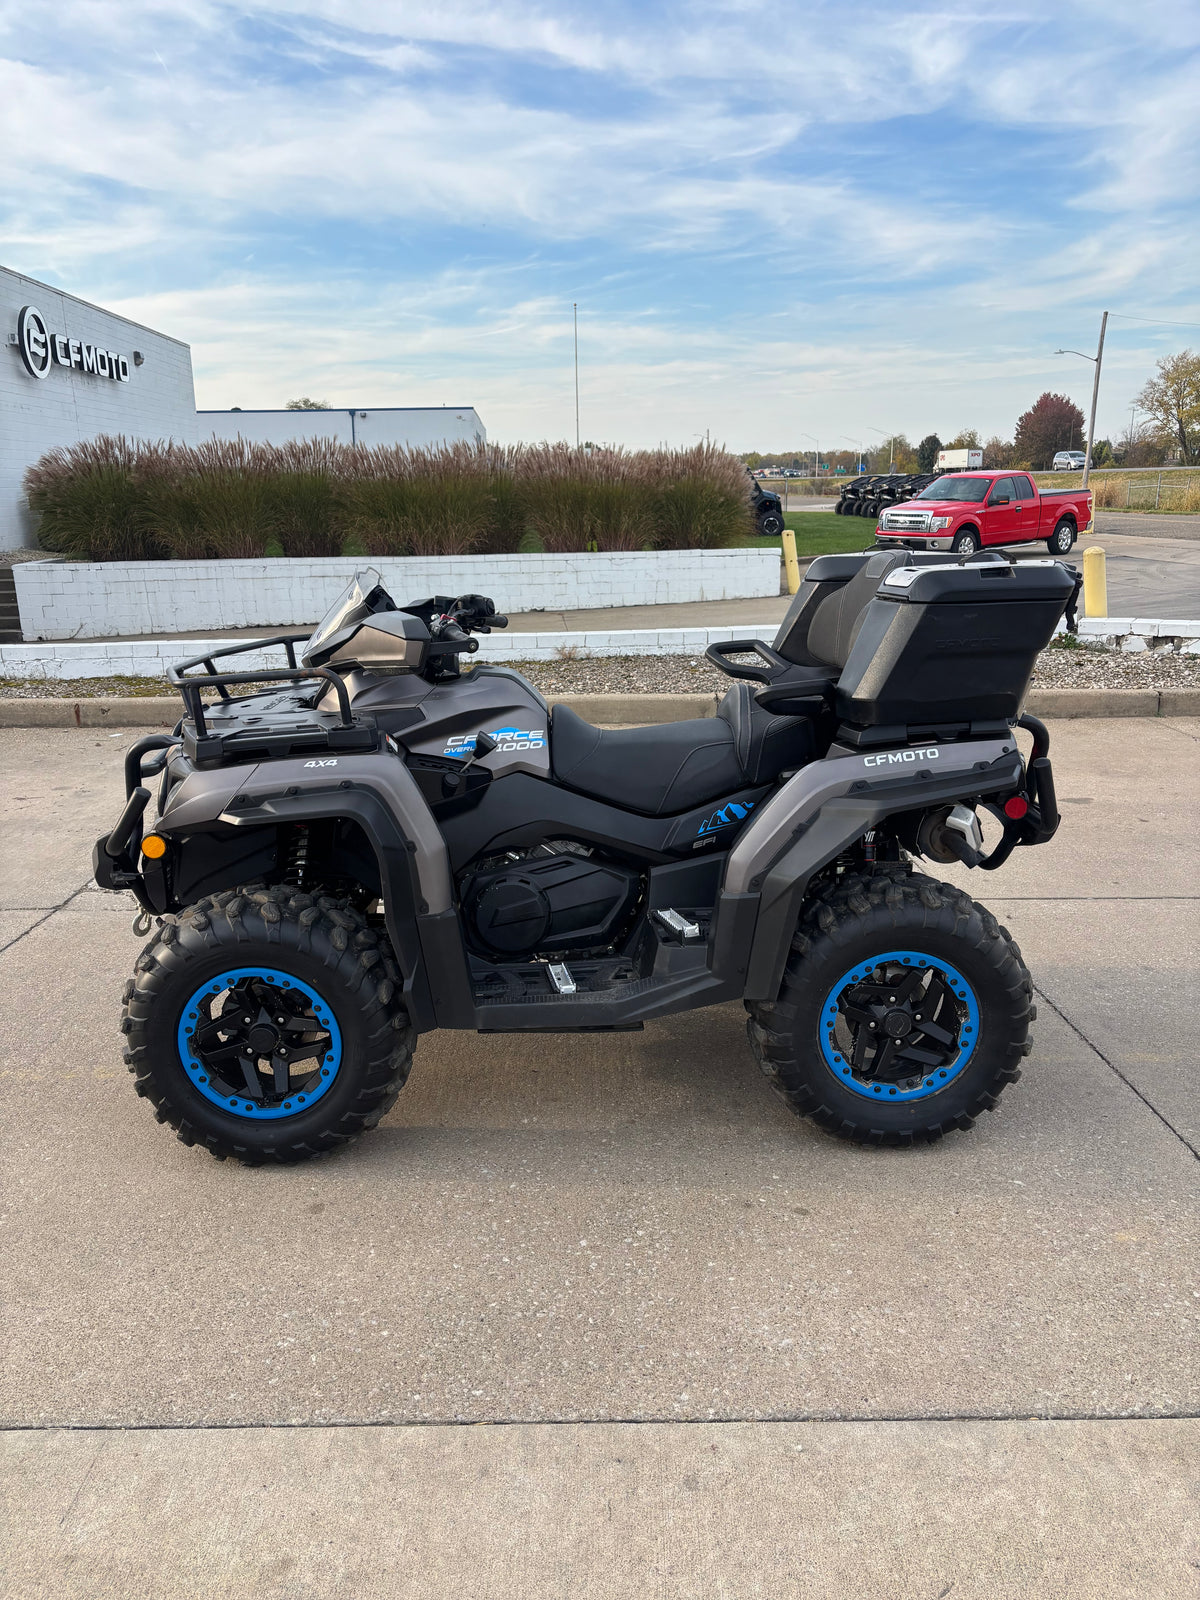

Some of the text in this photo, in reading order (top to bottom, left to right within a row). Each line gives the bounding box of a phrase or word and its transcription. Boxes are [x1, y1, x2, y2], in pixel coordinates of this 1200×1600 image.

[51, 334, 130, 382] CFMOTO
[443, 741, 543, 754] OVERL 1000
[864, 748, 939, 766] CFMOTO
[693, 836, 716, 848] EFI
